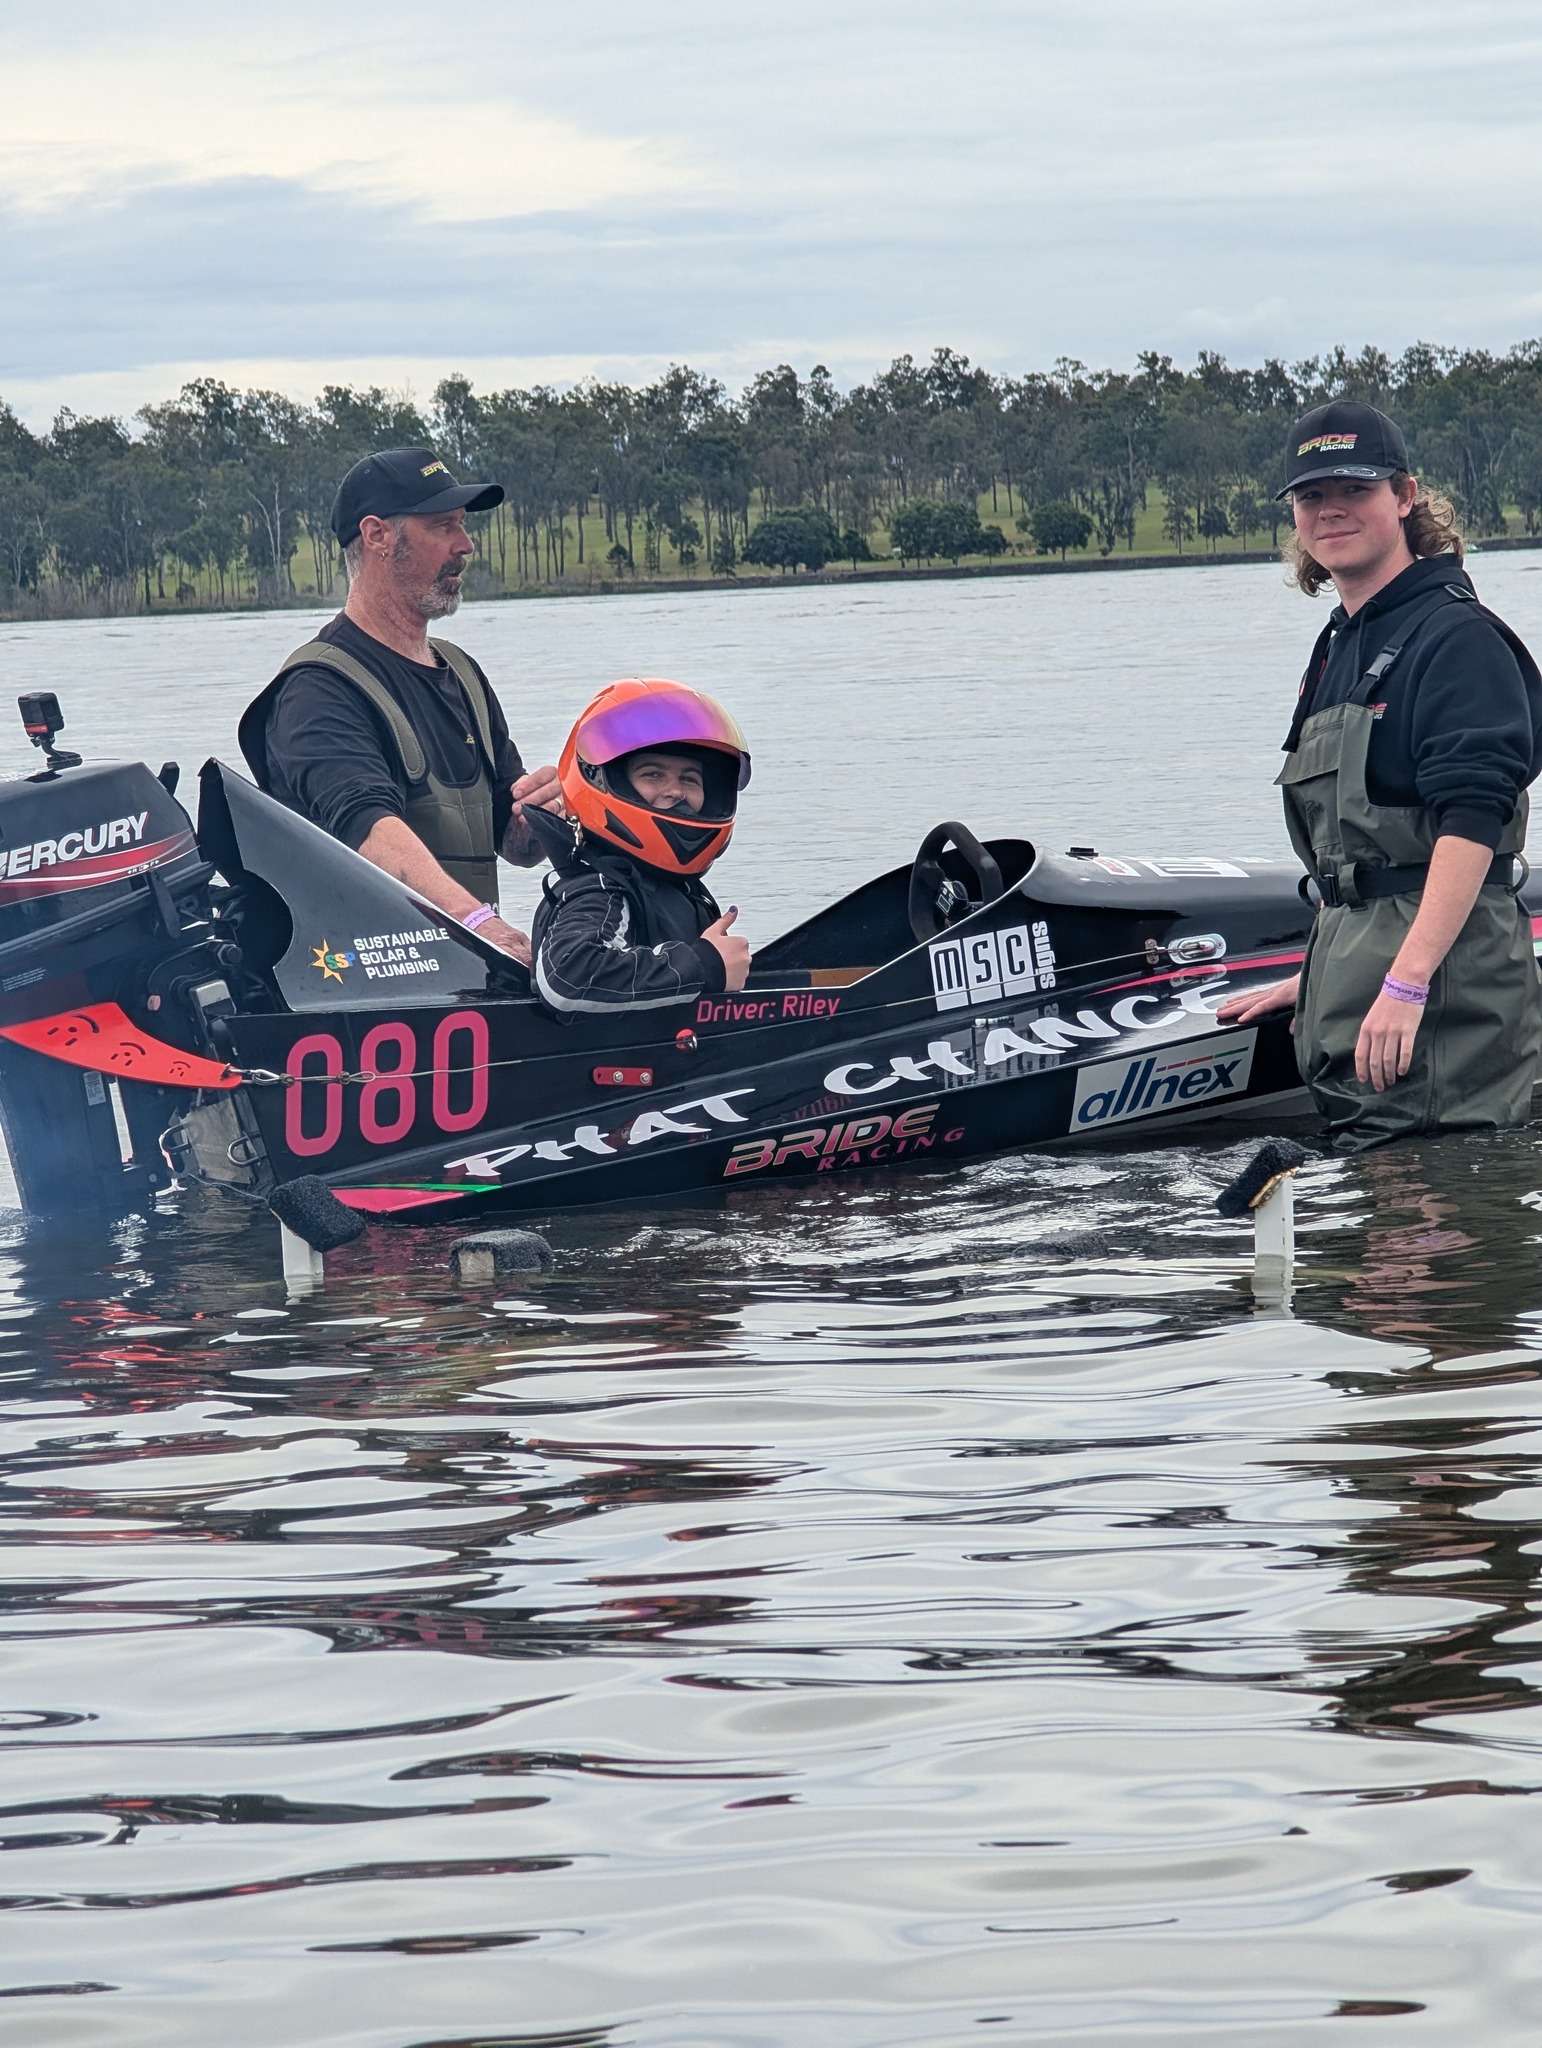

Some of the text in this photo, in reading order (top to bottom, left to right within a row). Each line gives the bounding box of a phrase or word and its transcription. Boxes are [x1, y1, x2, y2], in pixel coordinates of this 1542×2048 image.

[1297, 433, 1358, 456] BRIDE
[1320, 443, 1355, 452] RACING
[353, 927, 450, 951] SUSTAINABLE
[325, 951, 356, 969] SSP
[359, 946, 421, 966] SOLAR &
[365, 958, 440, 979] PLUMBING
[931, 931, 1028, 996] MSC
[696, 994, 841, 1023] Driver: Riley
[285, 1010, 490, 1157] 080
[443, 980, 1230, 1176] PHAT CHANCE
[1077, 1056, 1243, 1134] allnex
[723, 1103, 941, 1177] BRIDE
[816, 1127, 966, 1172] RACING
